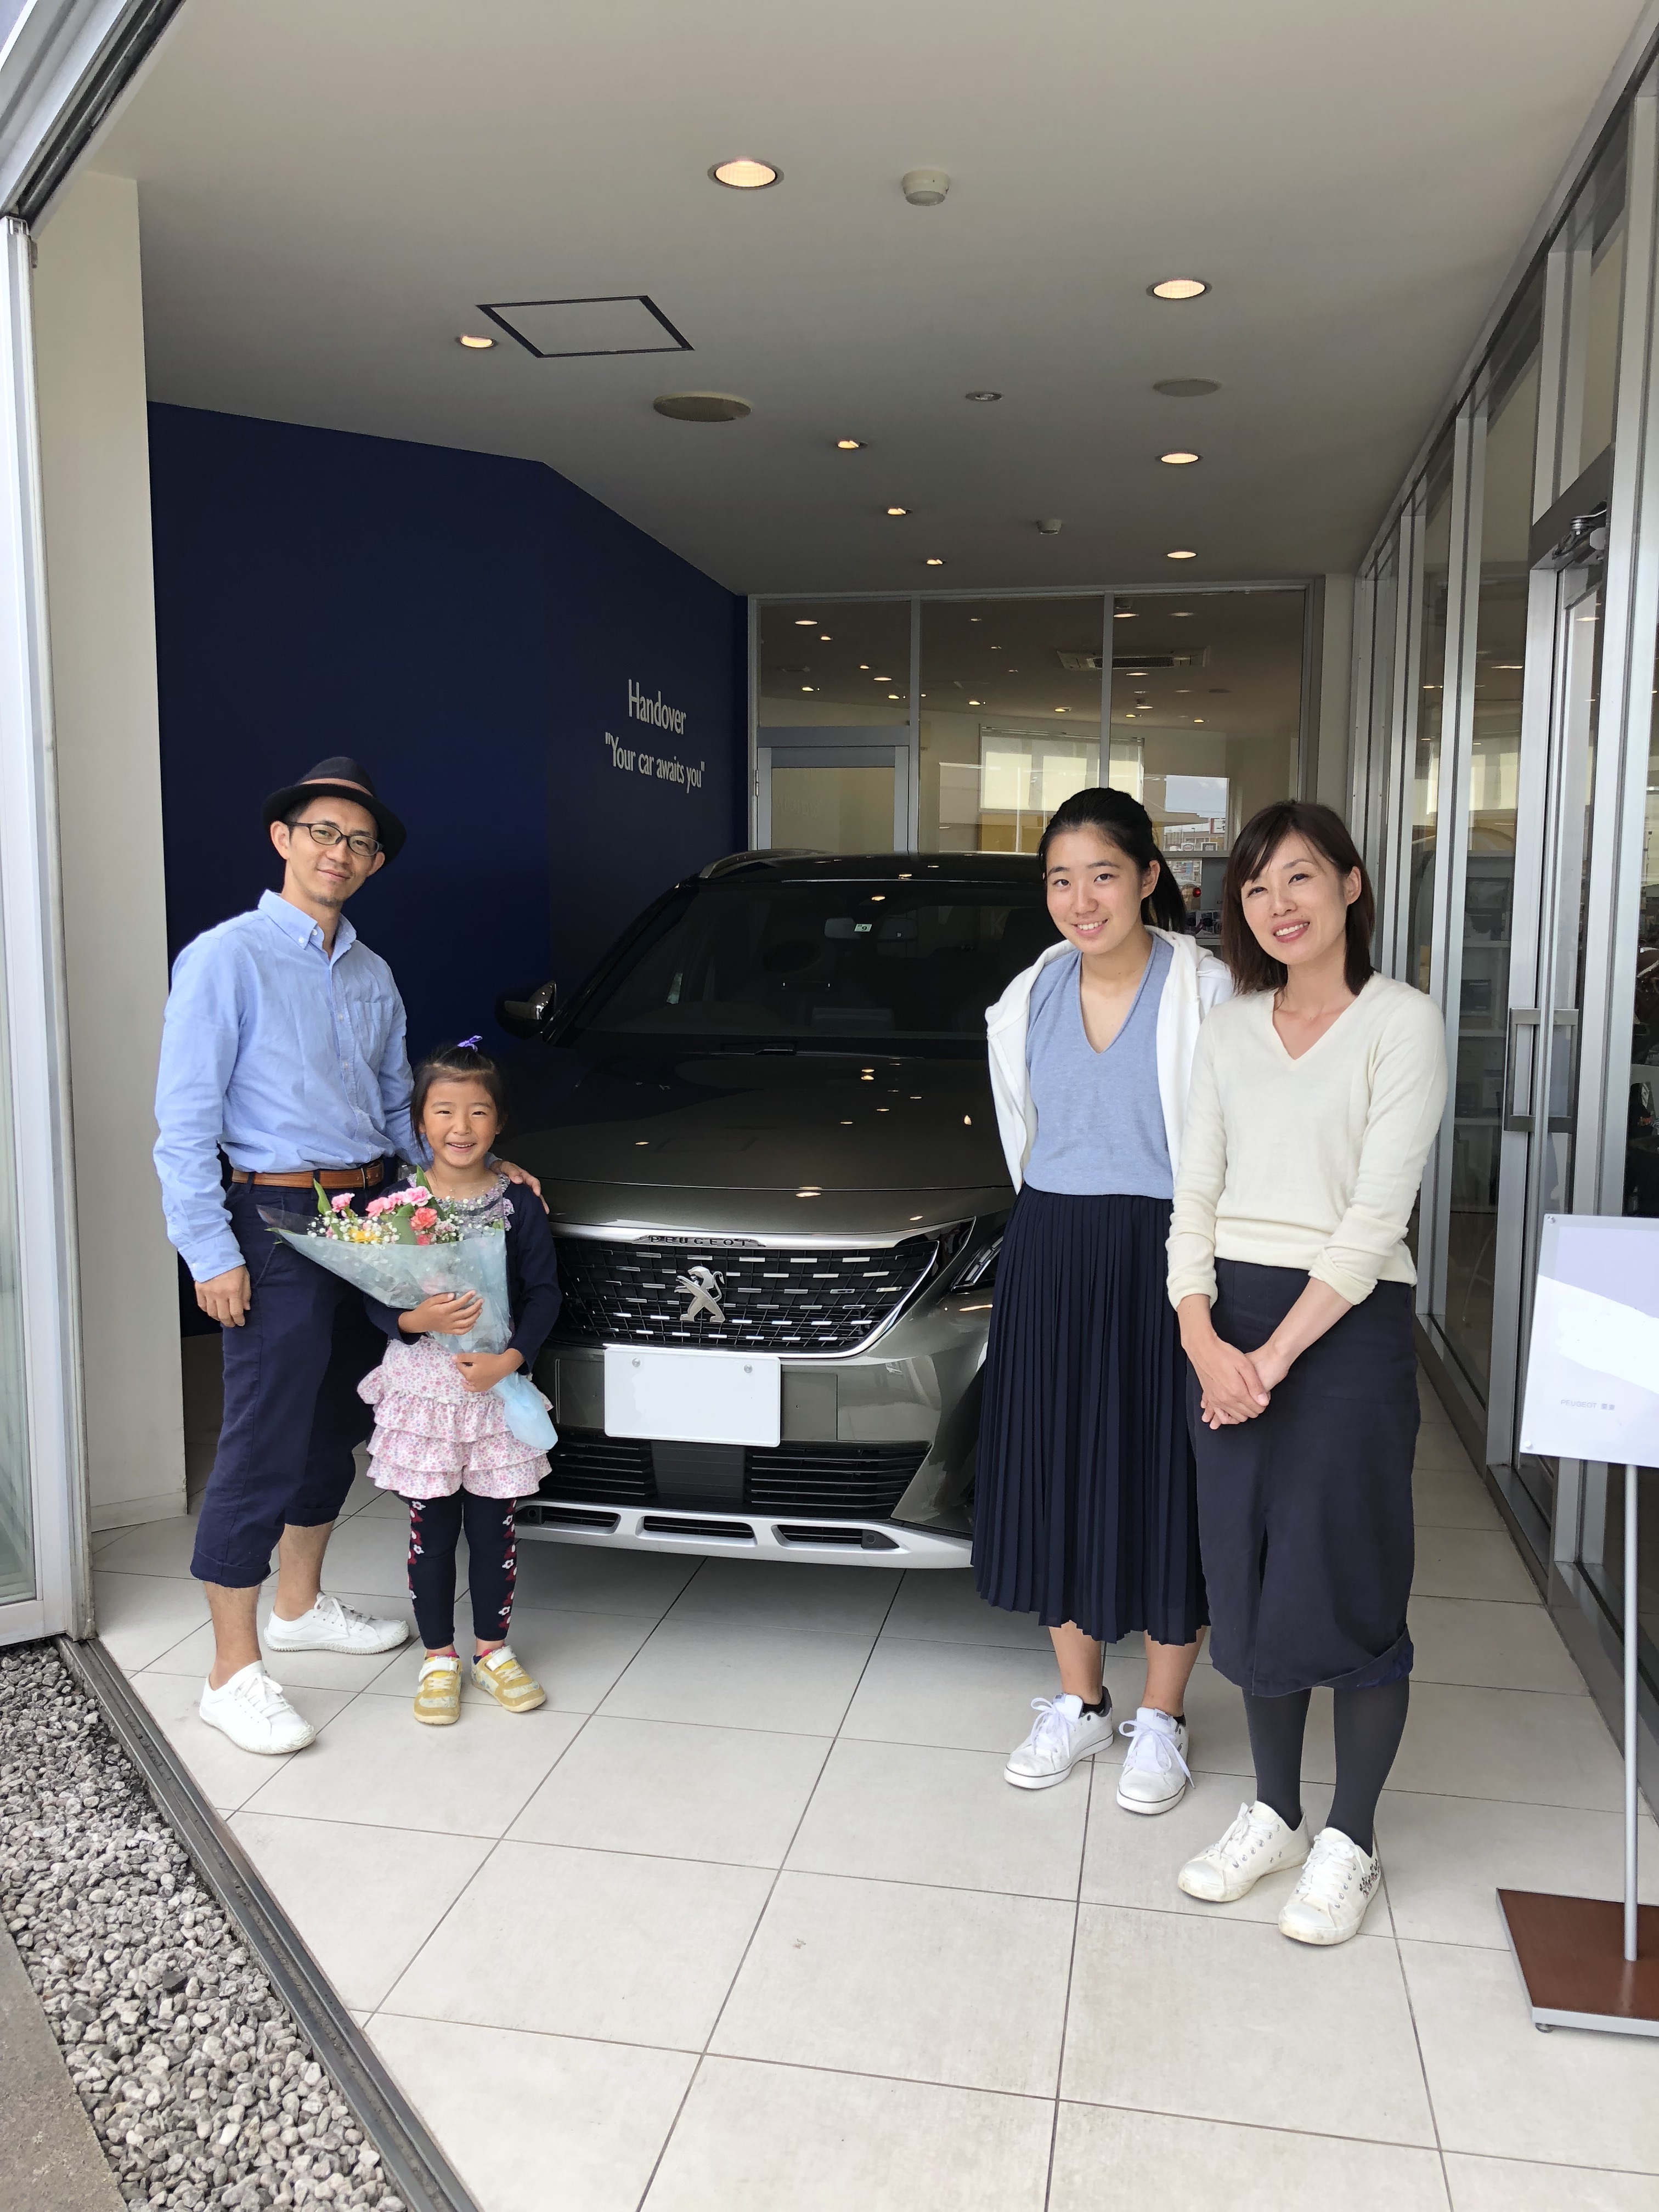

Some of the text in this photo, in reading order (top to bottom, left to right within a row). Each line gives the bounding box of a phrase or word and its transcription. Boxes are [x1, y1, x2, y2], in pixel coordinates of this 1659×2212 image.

[628, 679, 686, 735] Handover
[638, 753, 654, 776] car
[656, 755, 685, 784] awaits
[650, 1235, 751, 1248] PEUGEOT
[1560, 1399, 1598, 1409] PEUGEOT
